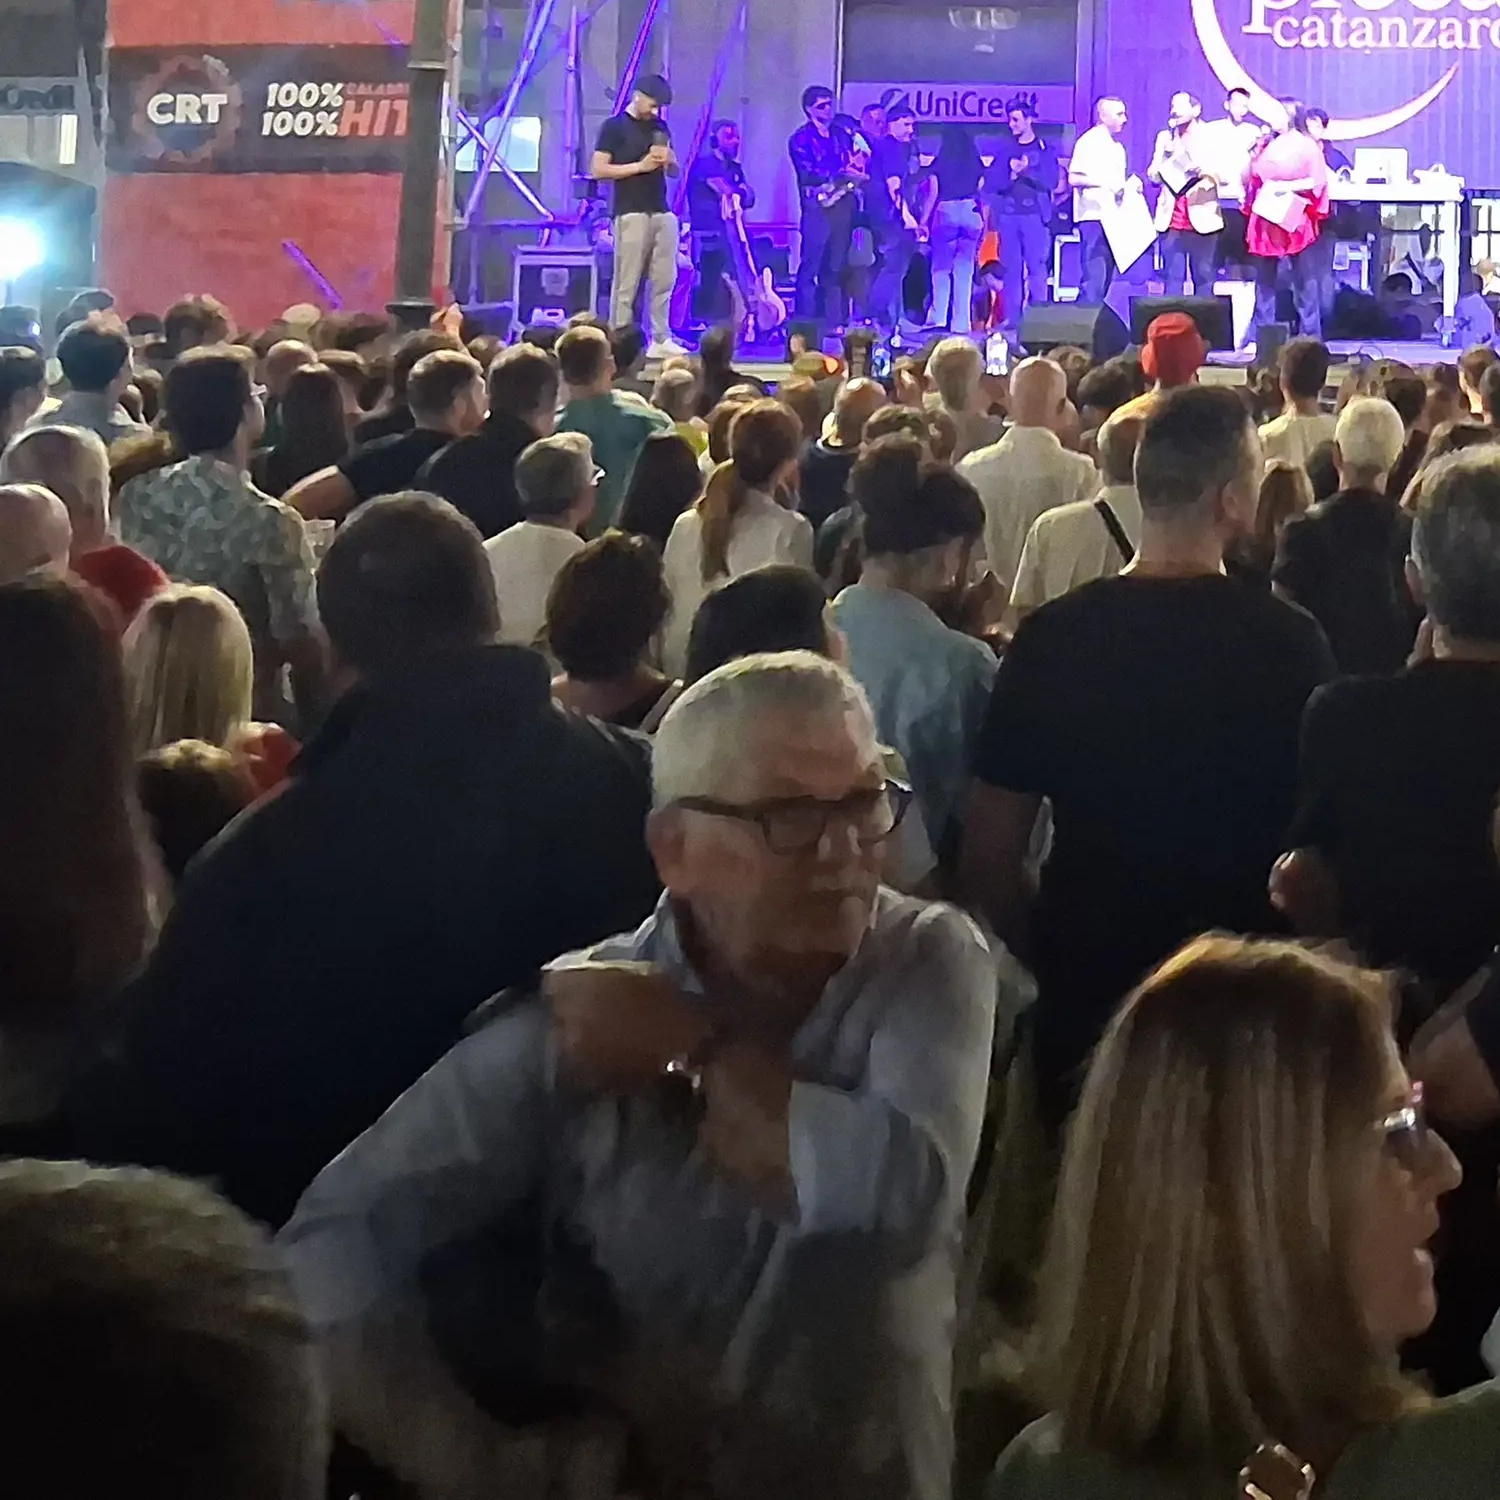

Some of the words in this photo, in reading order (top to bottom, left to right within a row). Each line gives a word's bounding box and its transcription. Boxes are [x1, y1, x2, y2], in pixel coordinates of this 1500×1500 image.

[146, 92, 228, 125] CRT
[266, 82, 344, 109] 100%
[261, 110, 339, 137] 100%
